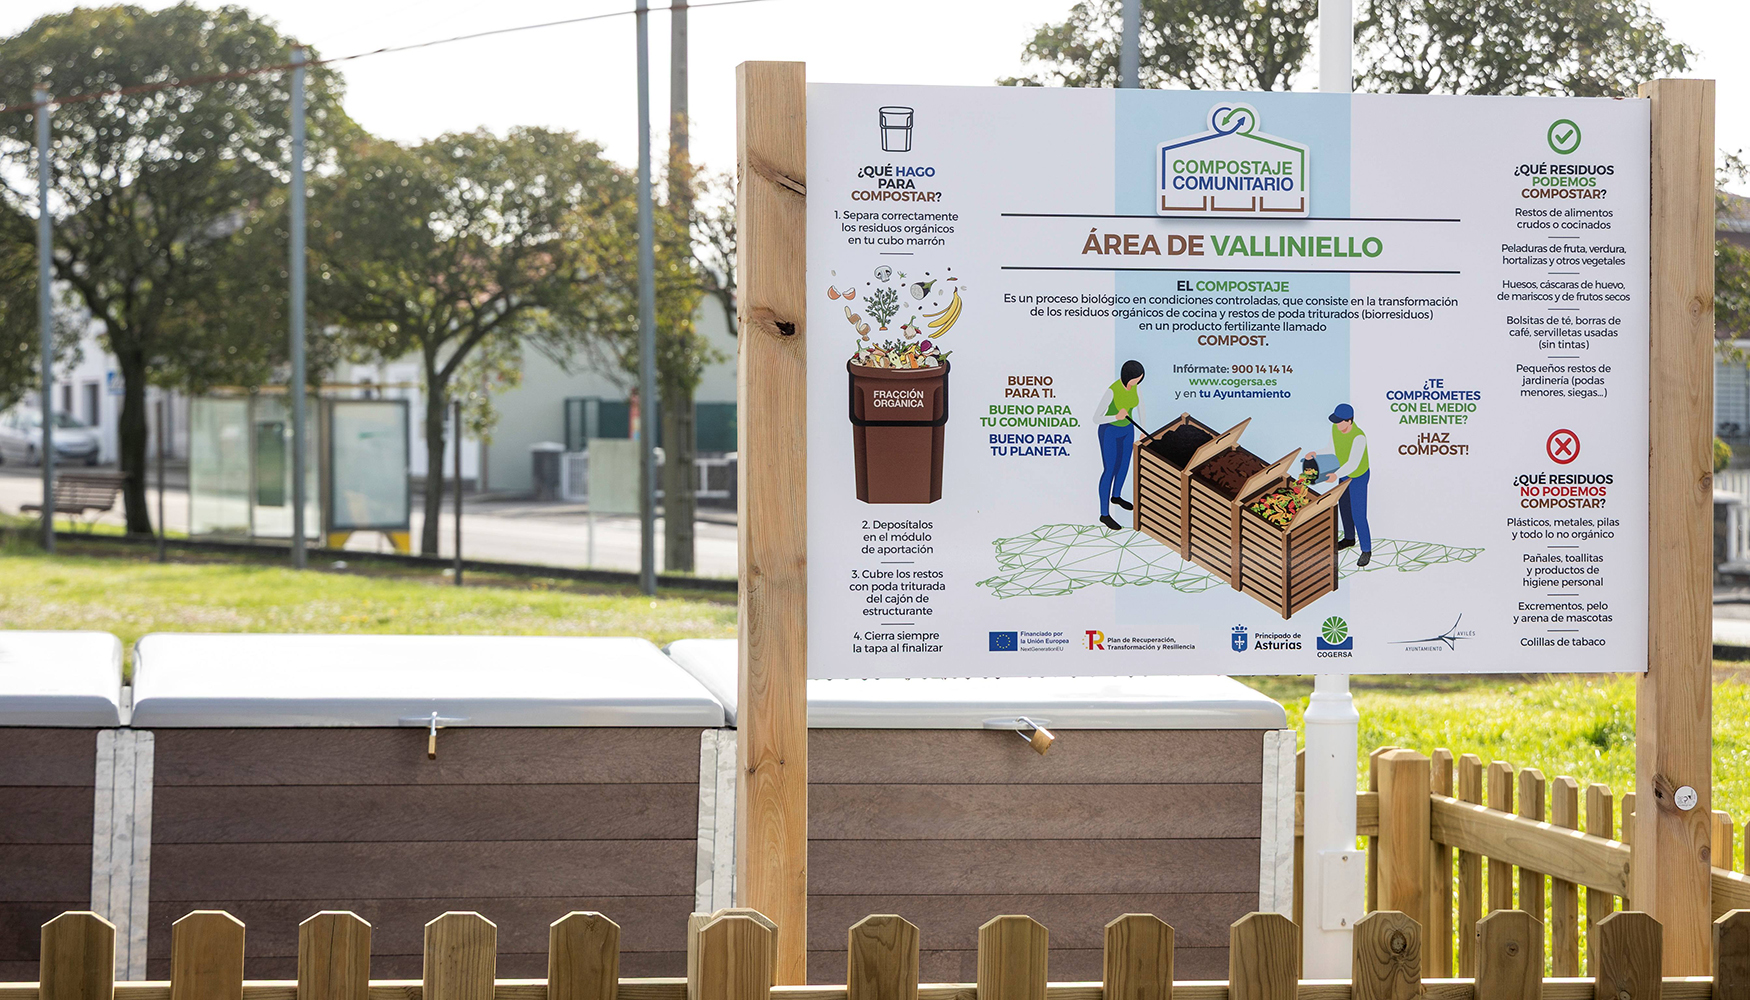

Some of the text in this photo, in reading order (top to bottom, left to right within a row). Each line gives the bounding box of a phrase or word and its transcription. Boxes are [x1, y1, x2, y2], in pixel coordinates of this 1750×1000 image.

[858, 164, 935, 178] ¿QUÉ HAGO
[1173, 160, 1292, 175] COMPOSTAJE
[1514, 162, 1614, 176] ¿QUÉ RESIDUOS
[879, 179, 915, 189] PARA
[1173, 176, 1293, 191] COMUNITARIO
[1533, 177, 1596, 187] PODEMOS
[852, 191, 942, 202] COMPOSTAR?
[1522, 189, 1607, 199] COMPOSTAR?
[834, 210, 958, 222] 1. Separa correctamente
[1516, 208, 1613, 217] Restos de alimentos
[842, 223, 954, 235] los residuos orgánicos
[1082, 227, 1383, 258] ÁREA DE VALLINIELLO
[1502, 244, 1626, 254] Peladuras de fruta, verdura,
[1177, 280, 1289, 292] EL COMPOSTAJE
[1503, 280, 1625, 289] Huesos, cáscaras de huevo,
[1004, 294, 1016, 303] Es
[1036, 296, 1078, 305] proceso
[1082, 294, 1130, 306] biológico
[1149, 295, 1213, 305] condiciones
[1216, 296, 1280, 306] controladas,
[1282, 298, 1303, 307] que
[1306, 296, 1349, 306] consiste
[1367, 296, 1375, 306] la
[1378, 297, 1458, 306] transformación
[1507, 316, 1621, 325] Bolsitas de té, borras de
[1173, 321, 1222, 333] producto
[1224, 321, 1280, 331] fertilizante
[1284, 322, 1327, 331] llamado
[1509, 328, 1618, 337] café, servilletas usadas
[1198, 335, 1269, 346] COMPOST.
[1539, 340, 1589, 350] (sin tintas)
[1174, 364, 1293, 373] Infórmate: 900 14 14 14
[1517, 364, 1611, 374] Pequeños restos de
[1008, 376, 1053, 386] BUENO
[1189, 379, 1277, 388] www.cogersa.es
[1424, 379, 1444, 390] ¿TE
[1522, 376, 1605, 387] jardinería (podas
[874, 388, 923, 399] FRACCIÓN
[1005, 388, 1056, 398] PARA TI.
[1175, 391, 1181, 400] y
[1199, 390, 1211, 398] tu
[1213, 389, 1291, 400] Ayuntamiento
[1386, 391, 1481, 400] COMPROMETES
[1568, 388, 1607, 399] siegas...)
[874, 397, 924, 408] ORGÁNICA
[1390, 403, 1477, 412] CON EL MEDIO
[990, 405, 1072, 415] BUENO PARA
[980, 418, 1080, 427] TU COMUNIDAD.
[1399, 415, 1468, 424] AMBIENTE?
[990, 434, 1072, 444] BUENO PARA
[1418, 433, 1450, 443] ¡HAZ
[991, 446, 1070, 456] TU PLANETA.
[1398, 444, 1469, 455] COMPOST!
[1514, 472, 1613, 487] ¿QUÉ RESIDUOS
[1521, 487, 1606, 496] NO PODEMOS
[1521, 498, 1606, 508] COMPOSTAR?
[862, 520, 933, 531] 2. Deposítalos
[1507, 518, 1620, 528] Plásticos, metales, pilas
[879, 532, 888, 541] el
[891, 532, 932, 541] módulo
[1524, 554, 1603, 563] Pañales, toallitas
[852, 570, 943, 579] 3. Cubre los restos
[872, 582, 898, 593] poda
[901, 582, 945, 591] triturada
[1523, 578, 1603, 588] higiene personal
[863, 607, 933, 616] estructurante
[1519, 602, 1608, 612] Excrementos, pelo
[854, 631, 939, 642] 4. Cierra siempre
[1255, 632, 1291, 640] Principado
[1255, 639, 1302, 650] Asturias
[1520, 637, 1606, 646] Colillas de tabaco
